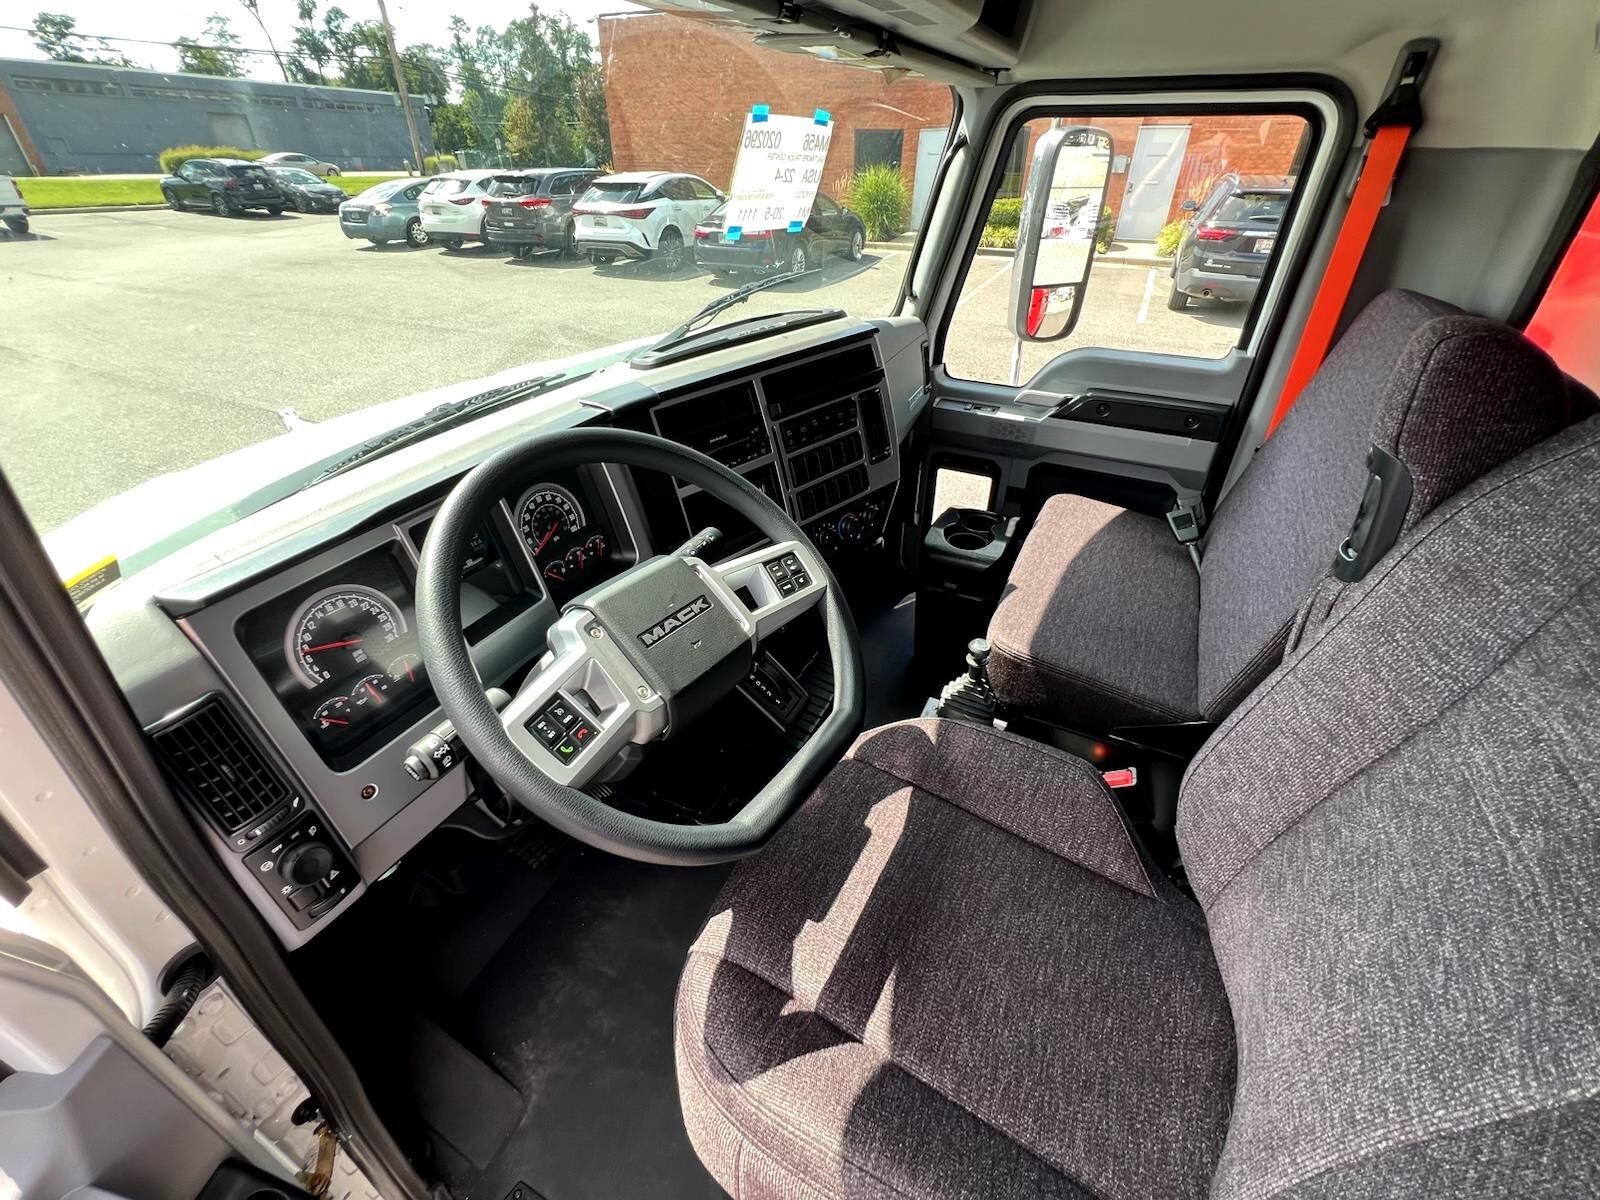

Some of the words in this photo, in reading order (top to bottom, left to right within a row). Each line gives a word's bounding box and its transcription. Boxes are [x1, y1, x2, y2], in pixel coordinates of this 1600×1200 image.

[307, 621, 317, 630] 12
[641, 598, 710, 645] MACK
[305, 655, 313, 663] 6
[312, 664, 320, 672] 4
[322, 671, 331, 680] 0
